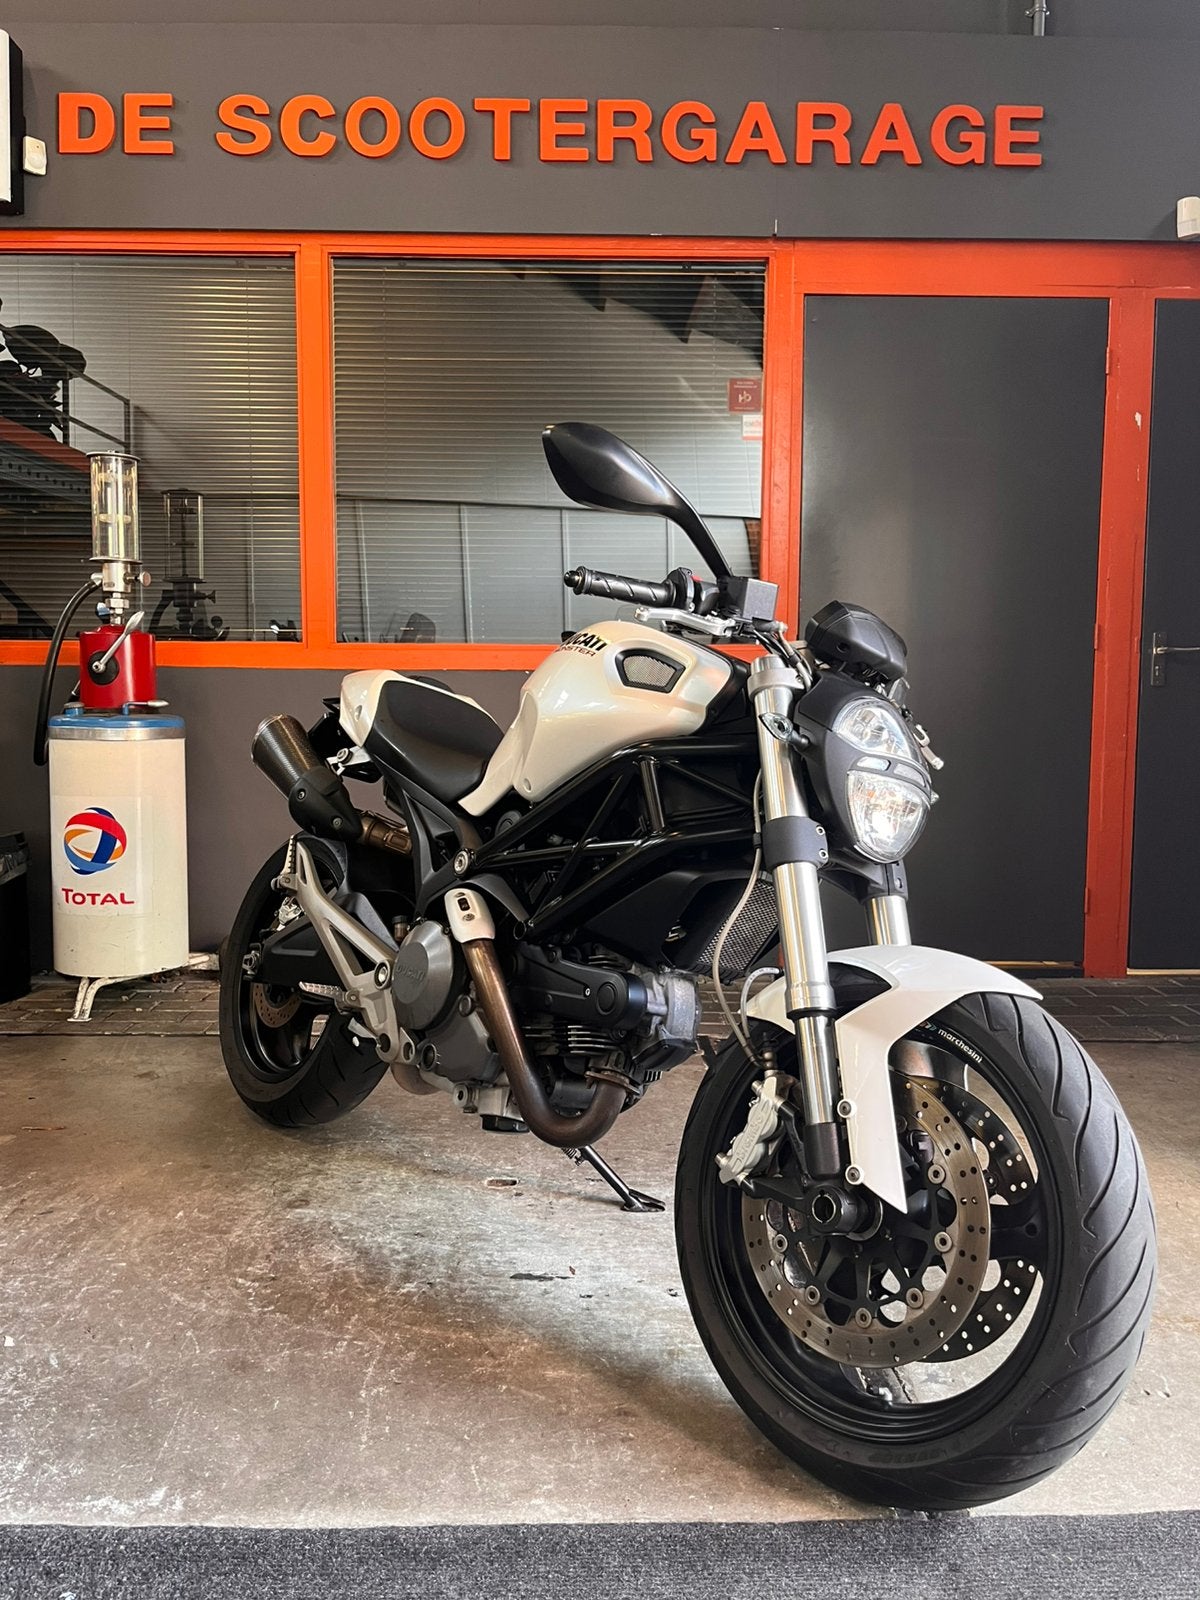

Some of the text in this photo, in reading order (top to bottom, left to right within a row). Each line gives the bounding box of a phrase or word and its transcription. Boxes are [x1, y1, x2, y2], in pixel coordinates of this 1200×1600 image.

[58, 92, 1045, 167] DE SCOOTERGARAGE
[562, 632, 608, 652] UCATI
[61, 887, 135, 906] TOTAL
[937, 1028, 983, 1064] marchesini
